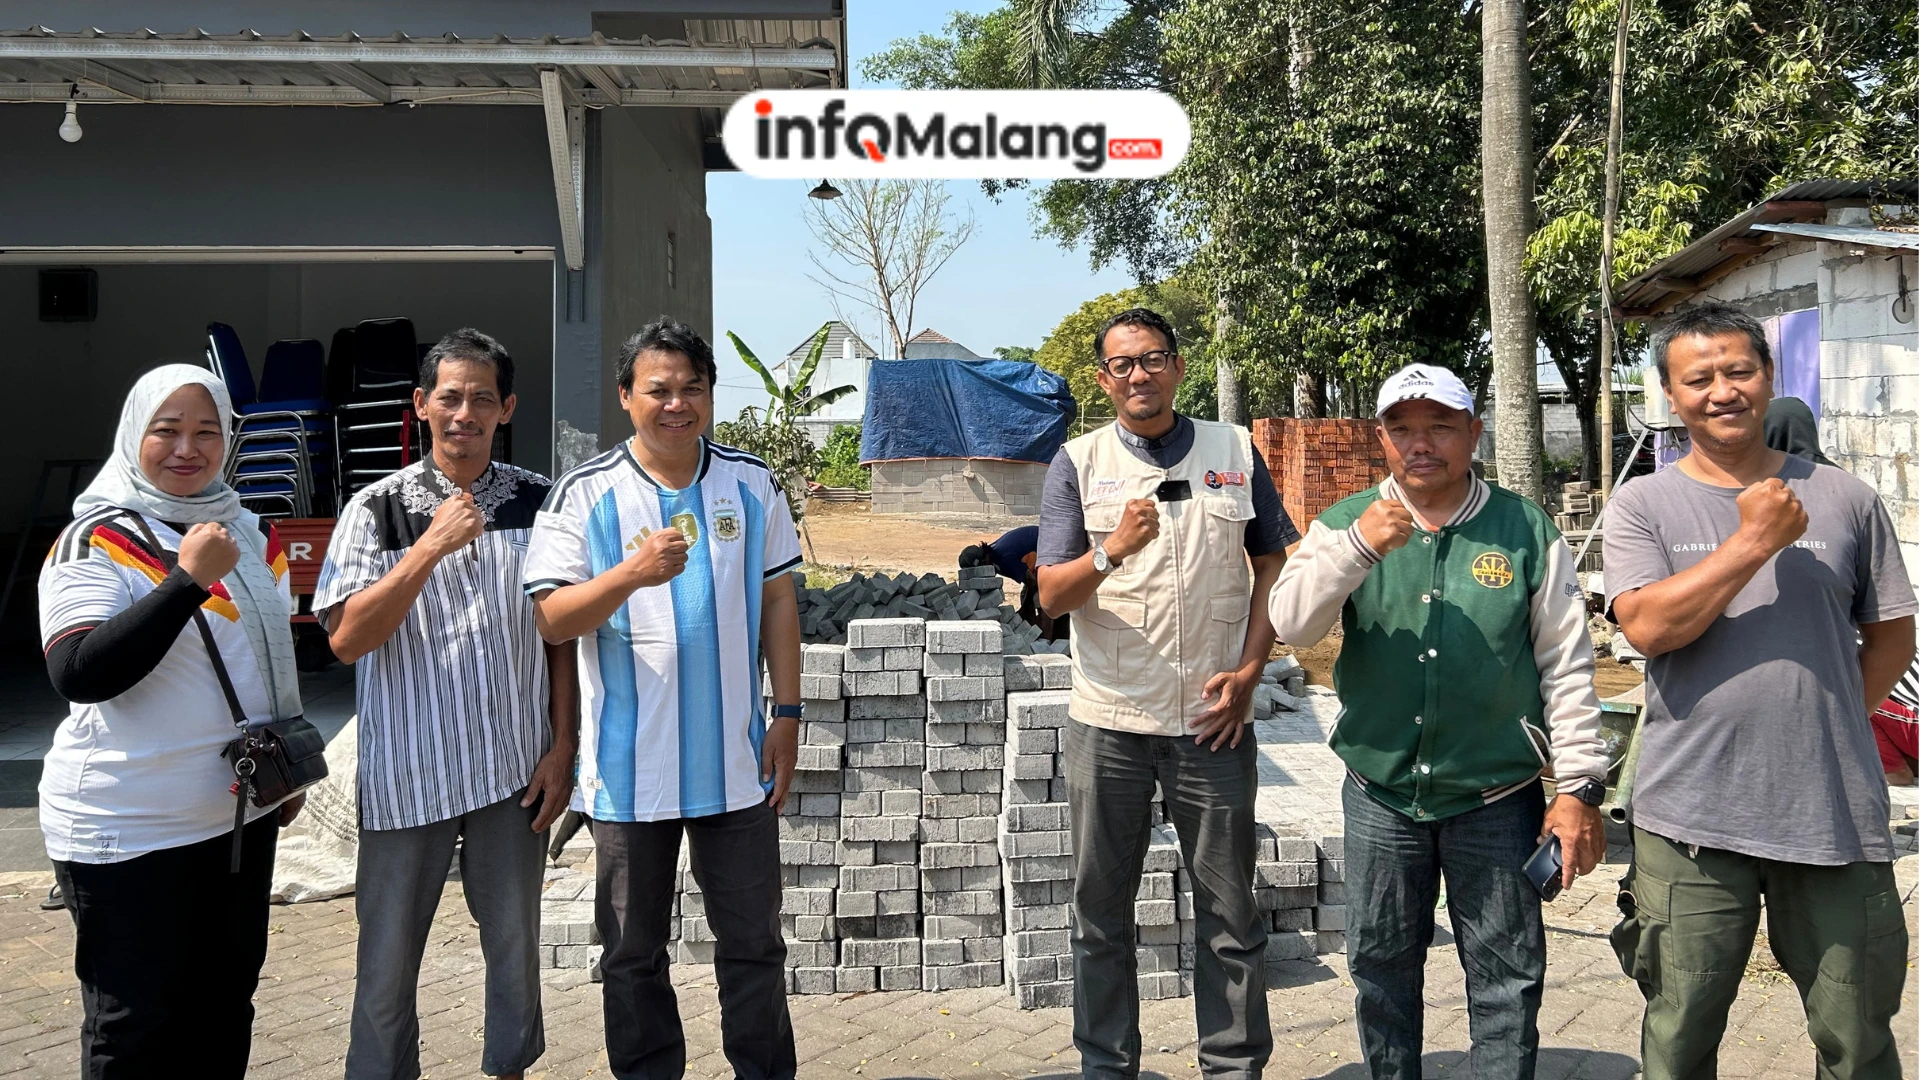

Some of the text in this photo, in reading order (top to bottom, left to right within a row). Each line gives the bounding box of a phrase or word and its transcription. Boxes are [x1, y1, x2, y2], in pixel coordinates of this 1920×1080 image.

[1398, 380, 1435, 390] adidas
[719, 517, 735, 532] AFA
[287, 542, 312, 560] R
[1673, 540, 1826, 552] GABRIE STRIES
